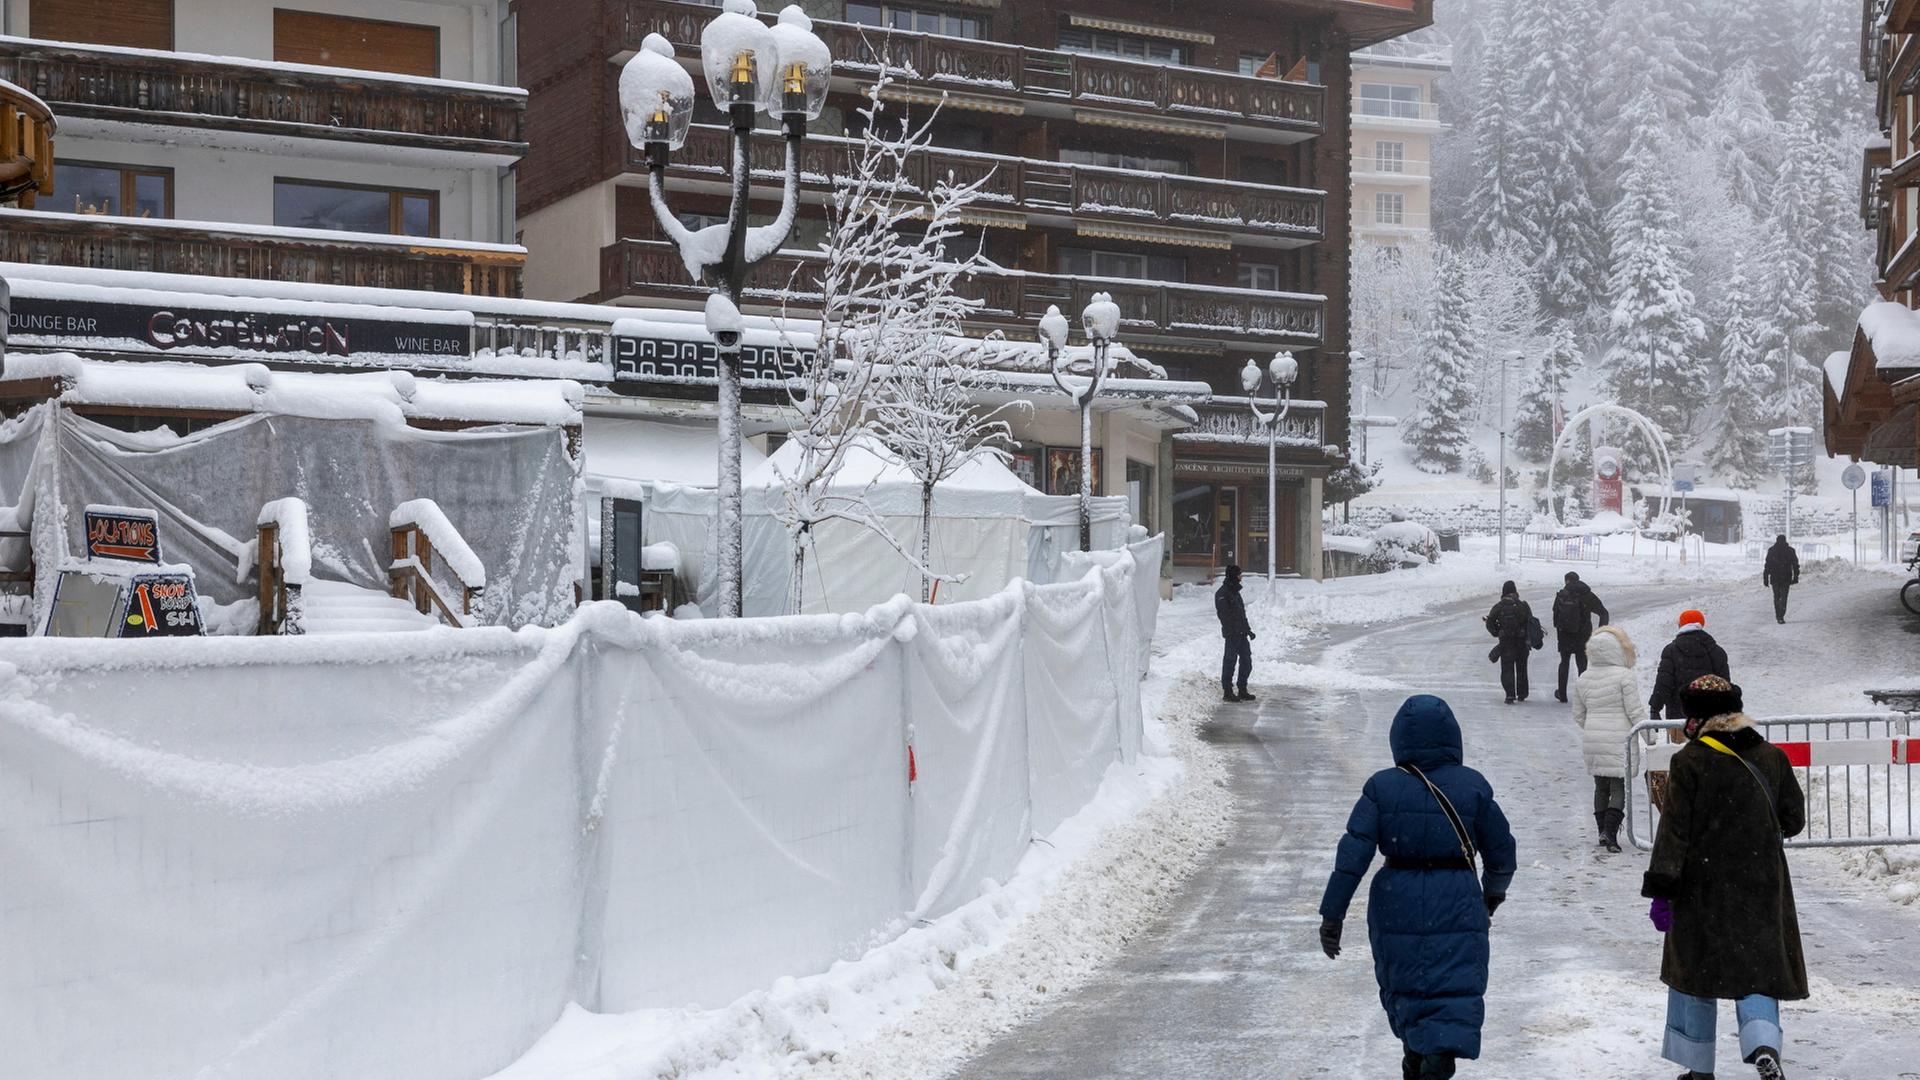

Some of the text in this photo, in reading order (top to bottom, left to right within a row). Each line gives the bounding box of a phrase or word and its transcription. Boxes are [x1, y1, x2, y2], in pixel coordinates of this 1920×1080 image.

[8, 313, 97, 332] OUNGE BAR
[394, 336, 460, 353] WINE BAR
[165, 611, 195, 626] SKI
